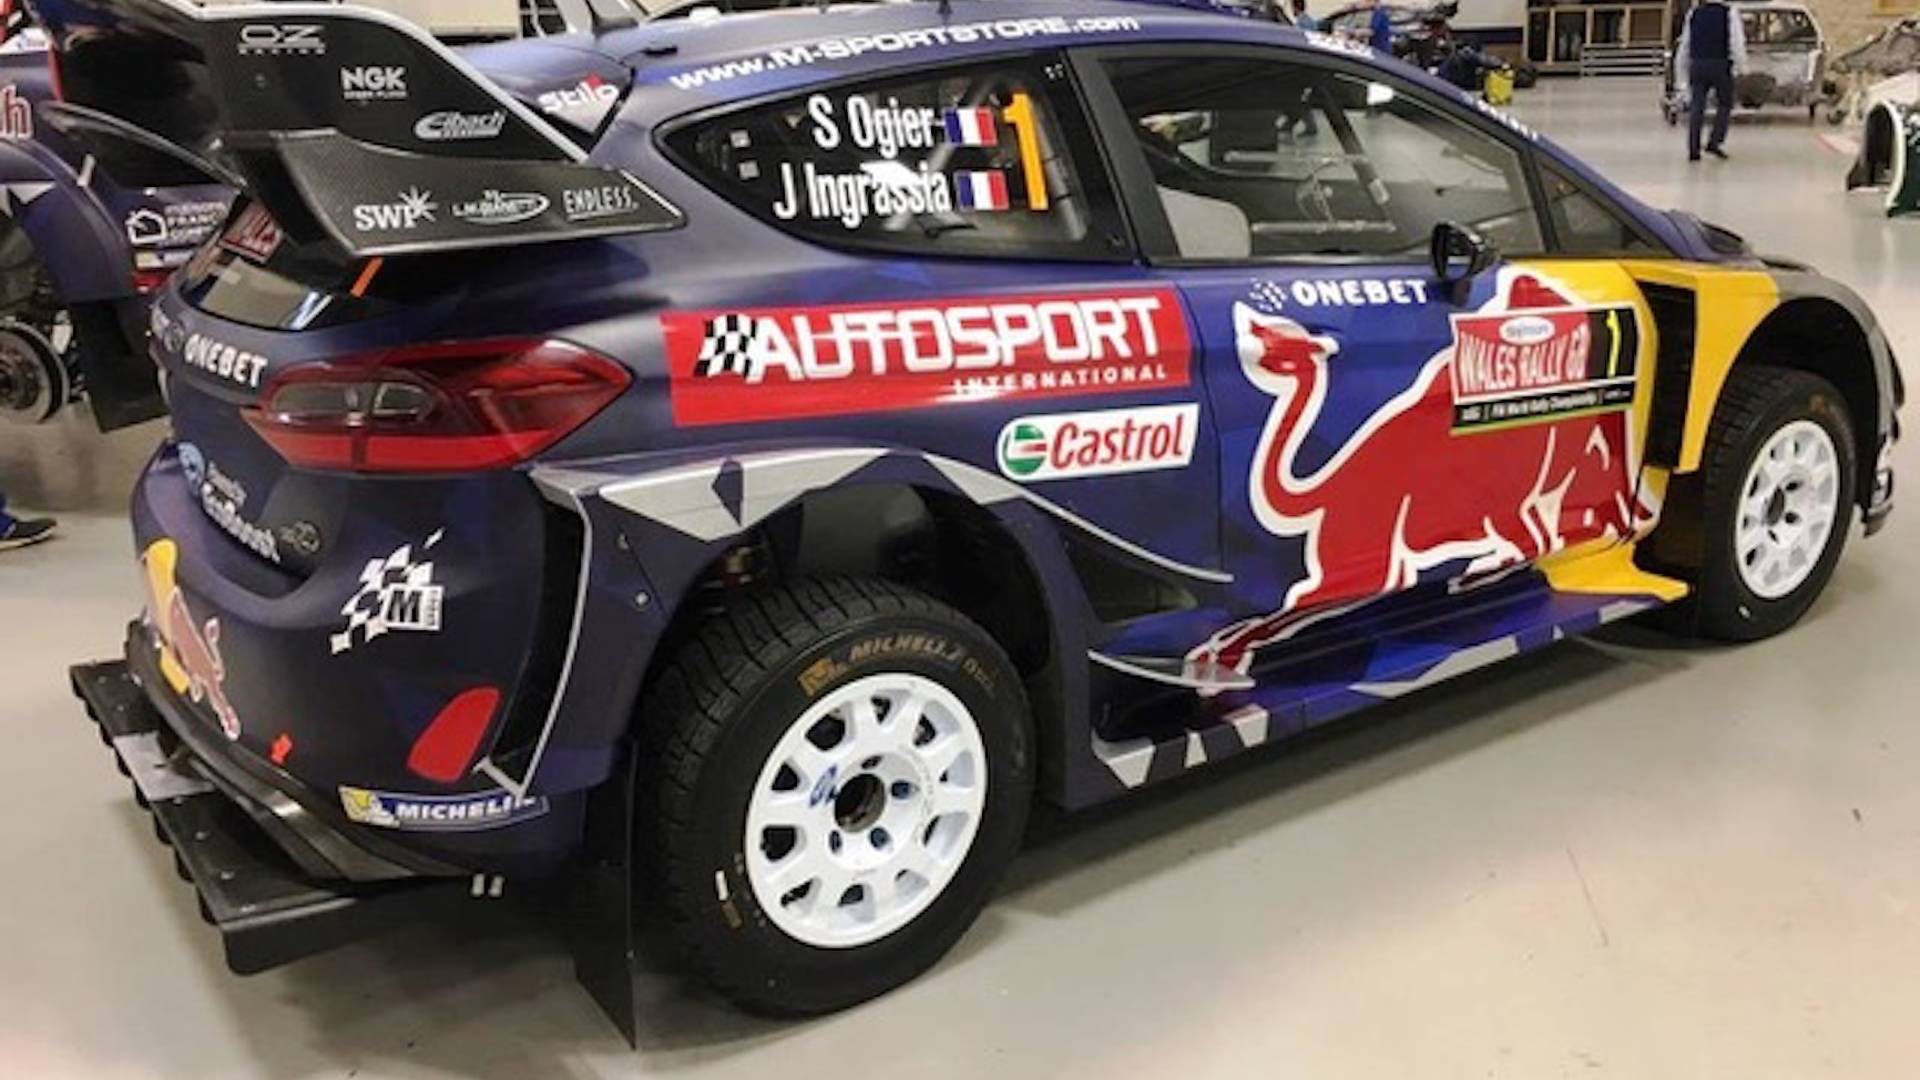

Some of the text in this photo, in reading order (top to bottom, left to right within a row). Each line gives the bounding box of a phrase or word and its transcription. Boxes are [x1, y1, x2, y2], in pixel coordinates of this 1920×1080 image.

[240, 24, 325, 43] OZ
[669, 15, 1140, 90] www.M-SPORTSTORE.com
[340, 66, 407, 91] NGK
[538, 80, 620, 113] Stilo
[808, 95, 935, 158] S Ogier
[1003, 93, 1048, 210] 1
[353, 203, 416, 231] SWP
[773, 161, 952, 229] J Ingrassia
[1291, 278, 1428, 307] ONEBET
[184, 333, 269, 388] ONEBET
[745, 297, 1161, 384] AUTOSPORT
[1459, 330, 1517, 396] WALES
[1519, 334, 1569, 387] RALLY
[1605, 309, 1621, 378] 1
[953, 364, 1168, 396] INTERNATIONAL
[1050, 412, 1185, 470] Castrol
